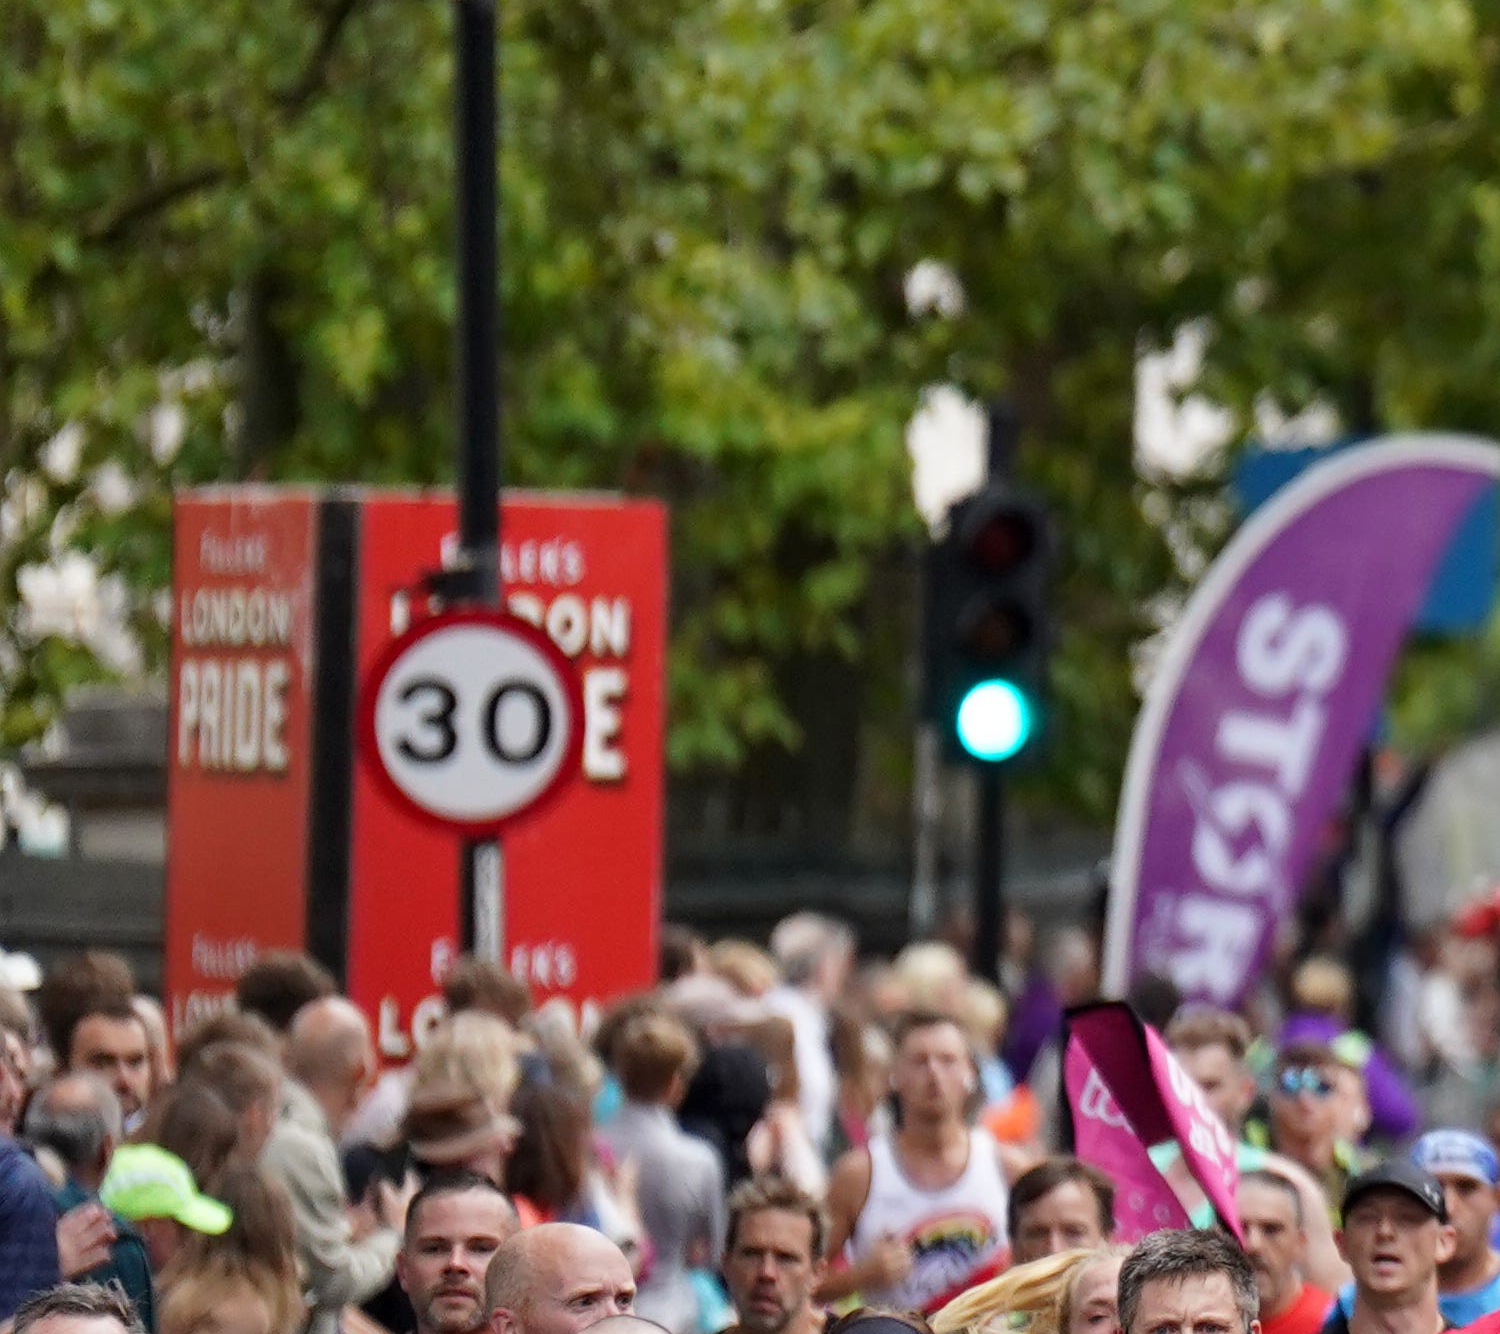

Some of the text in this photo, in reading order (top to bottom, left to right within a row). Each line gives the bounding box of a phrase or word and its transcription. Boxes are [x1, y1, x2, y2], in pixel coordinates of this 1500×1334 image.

[179, 588, 292, 648] LONDON
[389, 589, 632, 658] LON
[177, 657, 291, 773] PRIDE
[399, 676, 553, 765] 30
